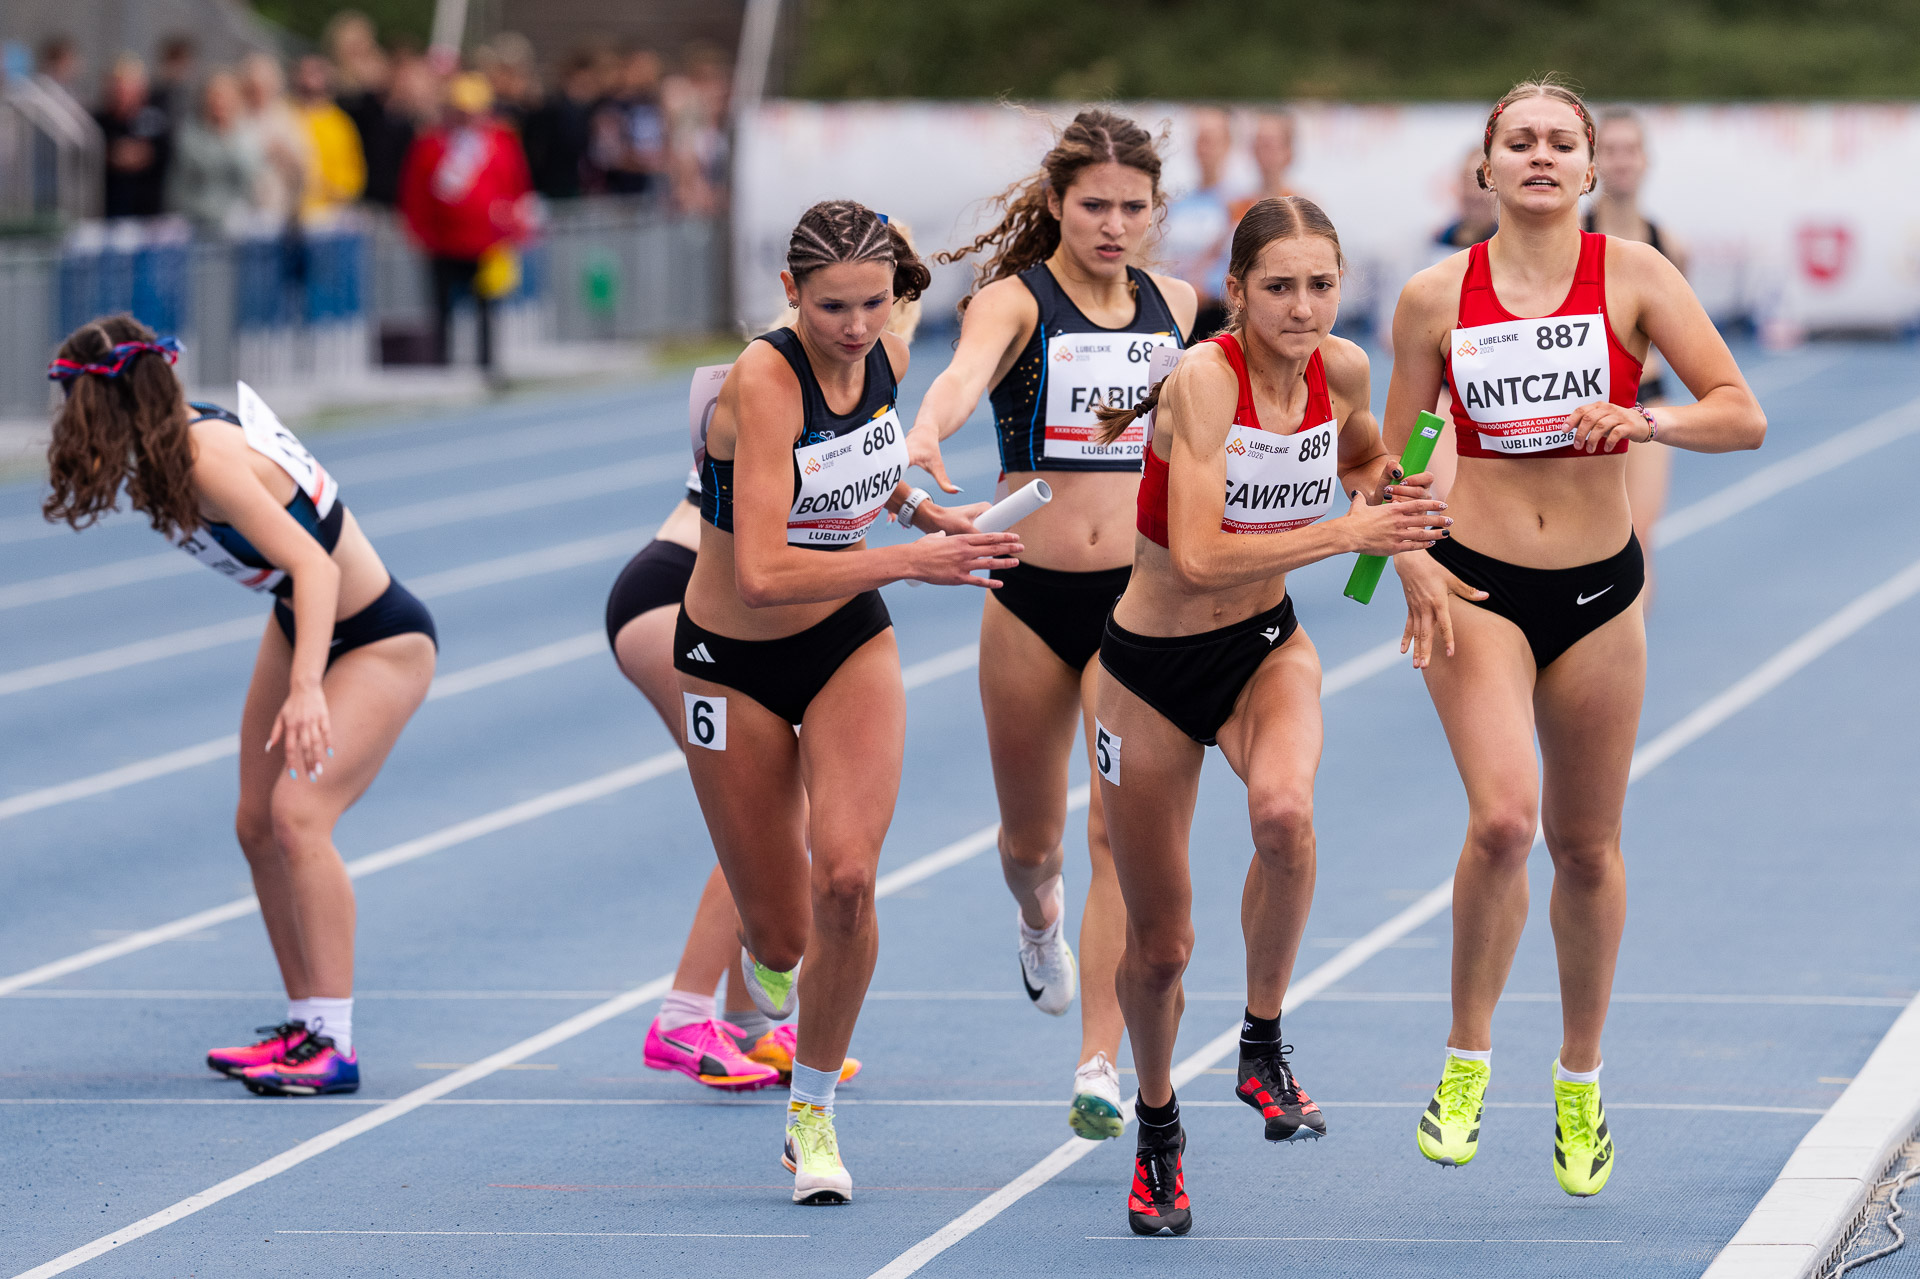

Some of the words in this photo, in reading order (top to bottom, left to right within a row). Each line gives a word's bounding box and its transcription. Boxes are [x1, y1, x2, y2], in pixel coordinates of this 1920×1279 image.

[1479, 334, 1519, 346] LUBELSKIE
[1536, 322, 1590, 350] 887
[1075, 345, 1111, 353] LUBELSKIE
[1127, 341, 1165, 363] 68
[1479, 346, 1494, 355] 2026
[1466, 368, 1603, 409] ANTCZAK
[1510, 425, 1545, 435] SPORTACH
[1545, 423, 1563, 432] LETNI
[863, 421, 895, 456] 680
[1249, 440, 1290, 454] LUBELSKIE
[1298, 430, 1331, 462] 889
[1501, 437, 1542, 449] LUBLIN
[1545, 432, 1574, 446] 2026
[822, 445, 852, 462] LUBELSKIE
[1082, 445, 1123, 455] LUBLIN
[1247, 450, 1264, 460] 2026
[796, 464, 902, 515] BOROWSKA
[1225, 477, 1332, 510] GAWRYCH
[808, 531, 850, 541] LUBLIN
[693, 700, 715, 744] 6
[1097, 727, 1112, 774] 5
